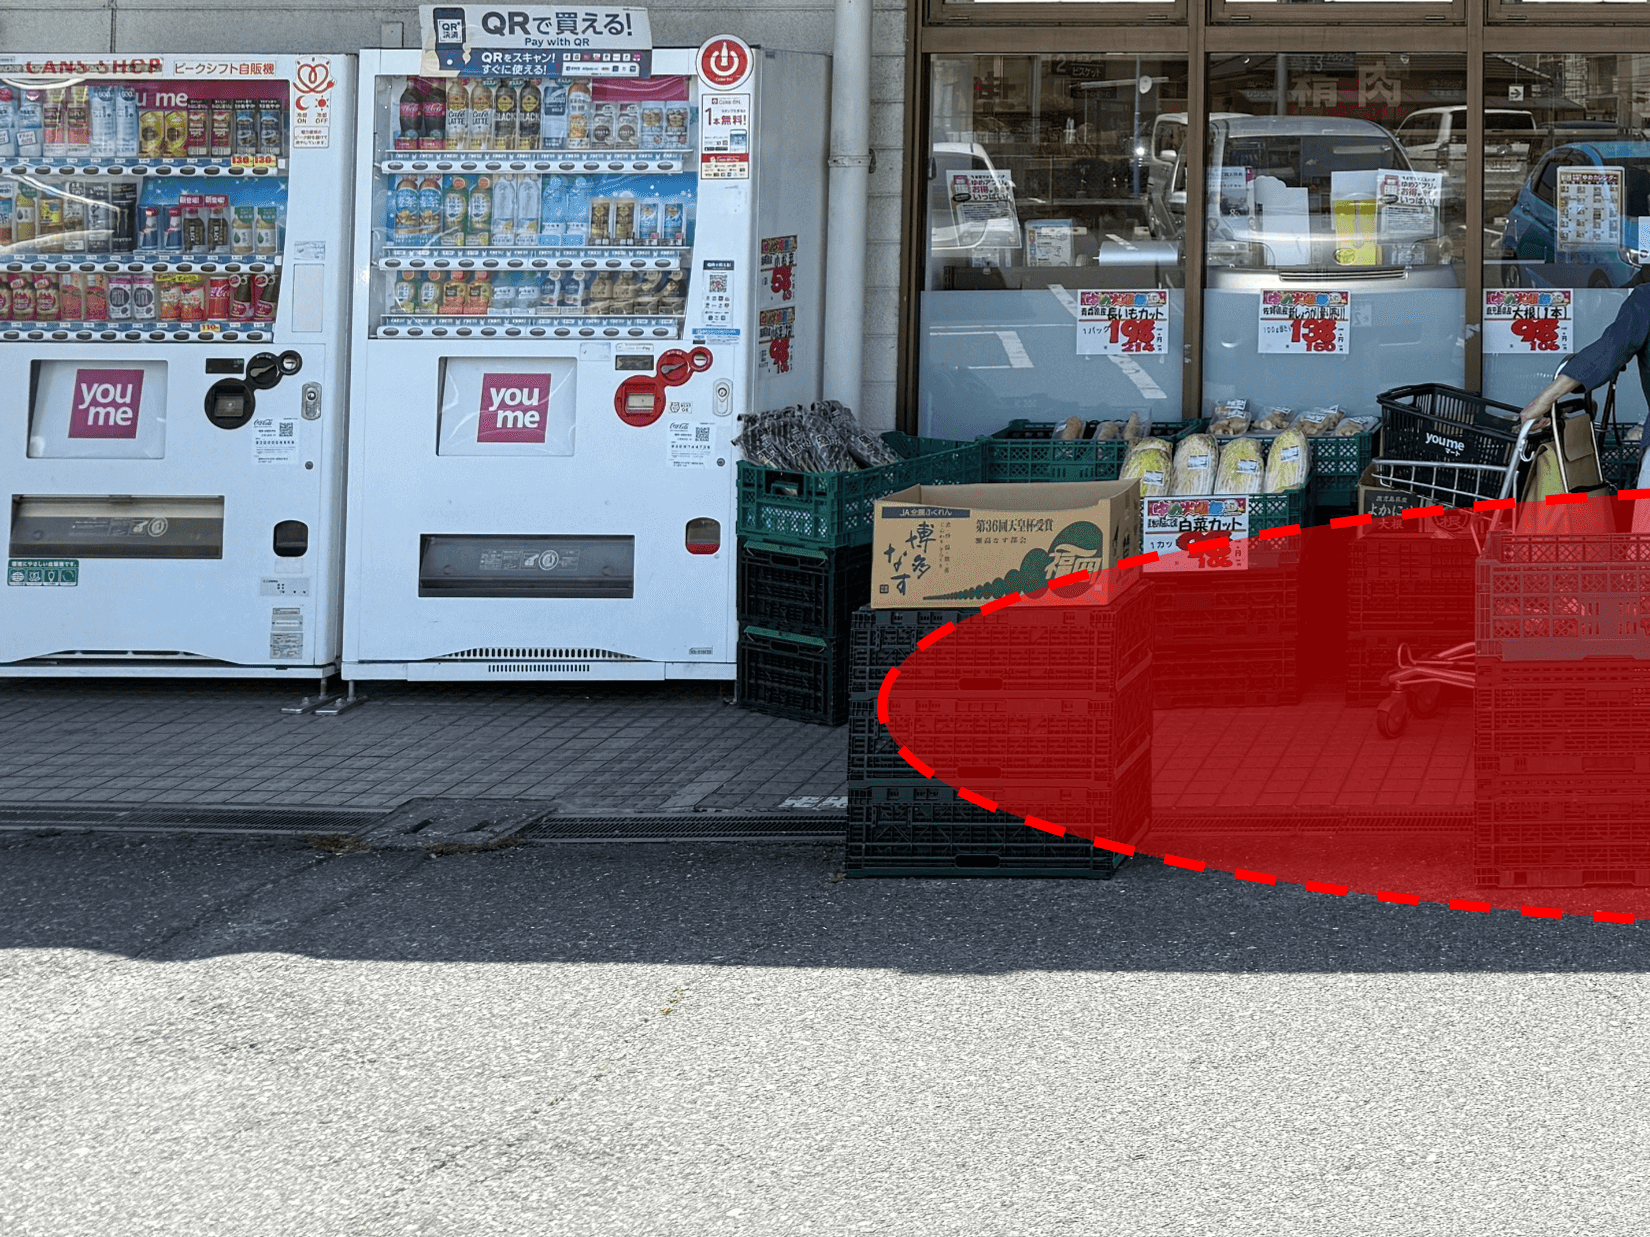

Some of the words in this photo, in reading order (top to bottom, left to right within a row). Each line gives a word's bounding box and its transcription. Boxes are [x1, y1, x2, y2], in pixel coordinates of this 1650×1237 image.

[481, 11, 633, 36] QRで買える!
[525, 38, 551, 47] Pay
[553, 38, 571, 46] with
[574, 38, 590, 47] QR
[481, 52, 556, 63] QRをスキャン!
[174, 62, 276, 76] ピークシフト自販機
[481, 65, 548, 76] すぐに使える!
[1108, 308, 1164, 320] 長いもカット
[80, 381, 134, 409] you
[489, 387, 539, 412] you
[87, 404, 134, 426] me
[496, 408, 540, 429] me
[1444, 447, 1461, 457] マート
[1367, 503, 1415, 517] よかに
[1179, 517, 1242, 532] 白菜カット
